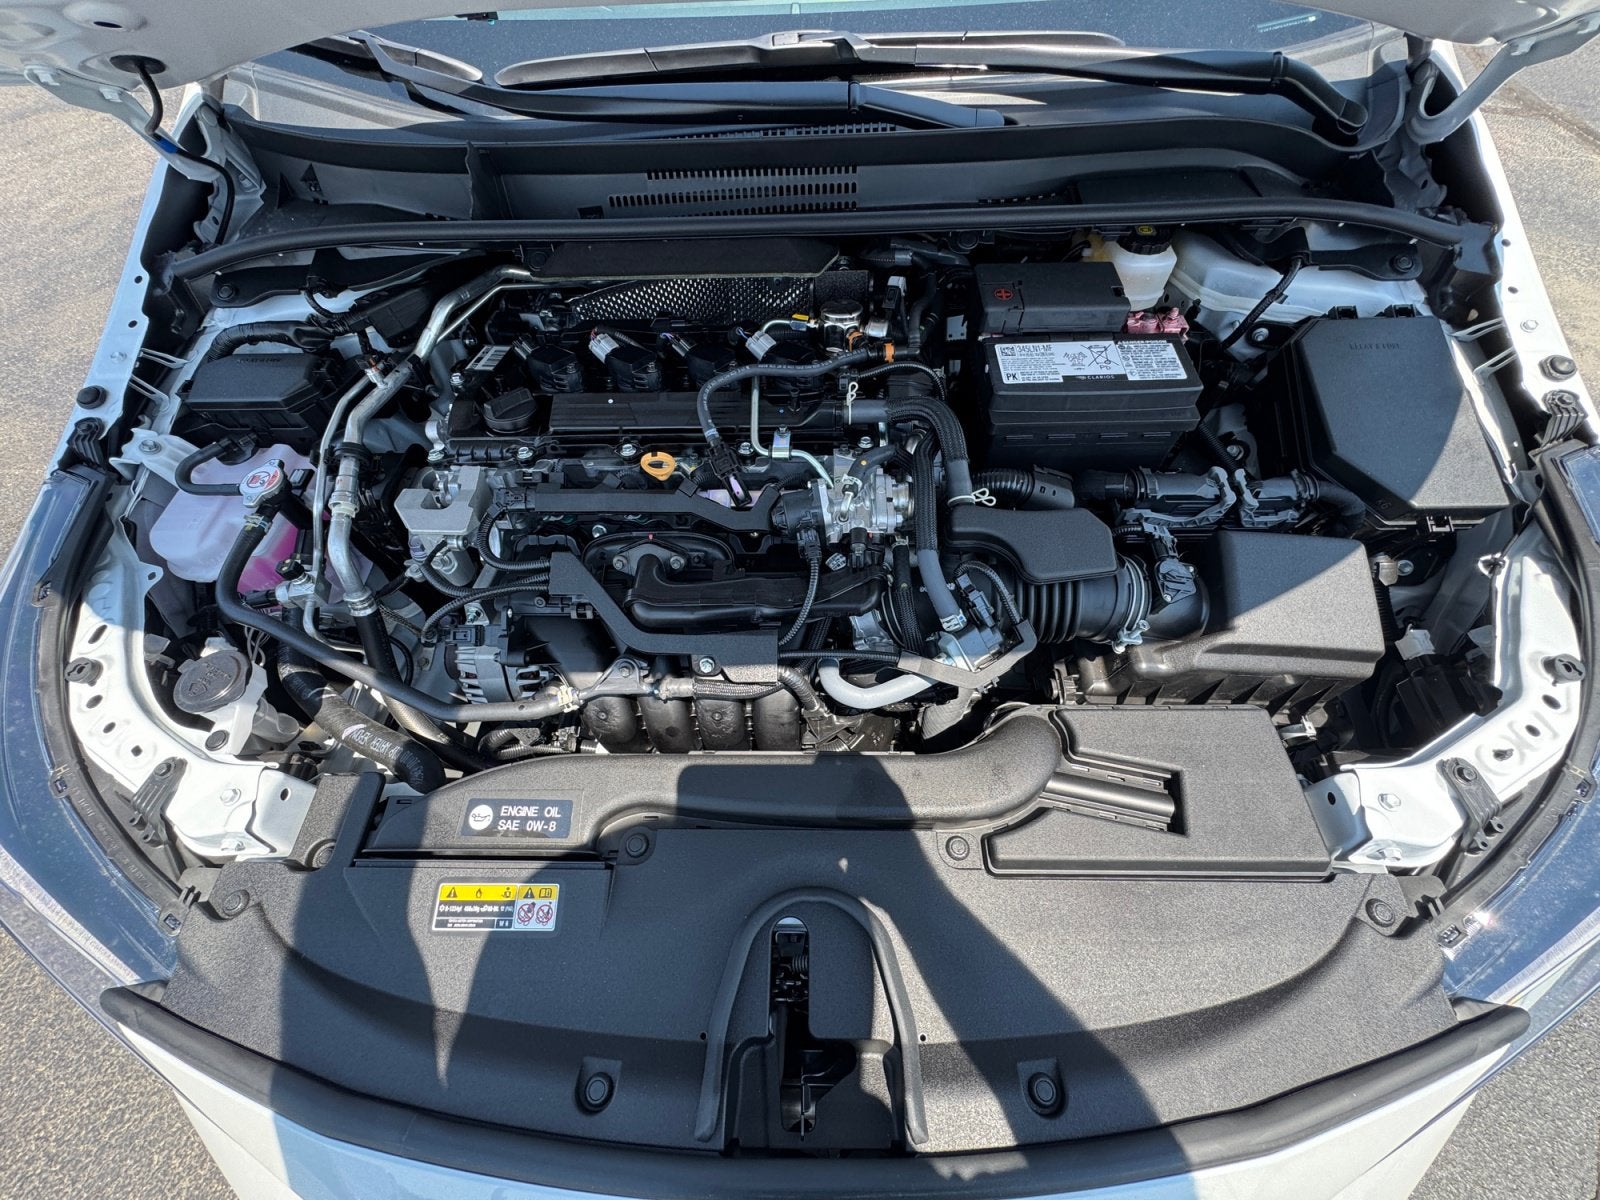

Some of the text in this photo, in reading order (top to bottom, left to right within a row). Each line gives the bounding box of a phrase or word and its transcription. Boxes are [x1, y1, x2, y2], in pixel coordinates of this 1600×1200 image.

[1006, 372, 1018, 381] PK
[501, 806, 561, 817] ENGINE OIL
[498, 820, 556, 832] SAE 0W-8
